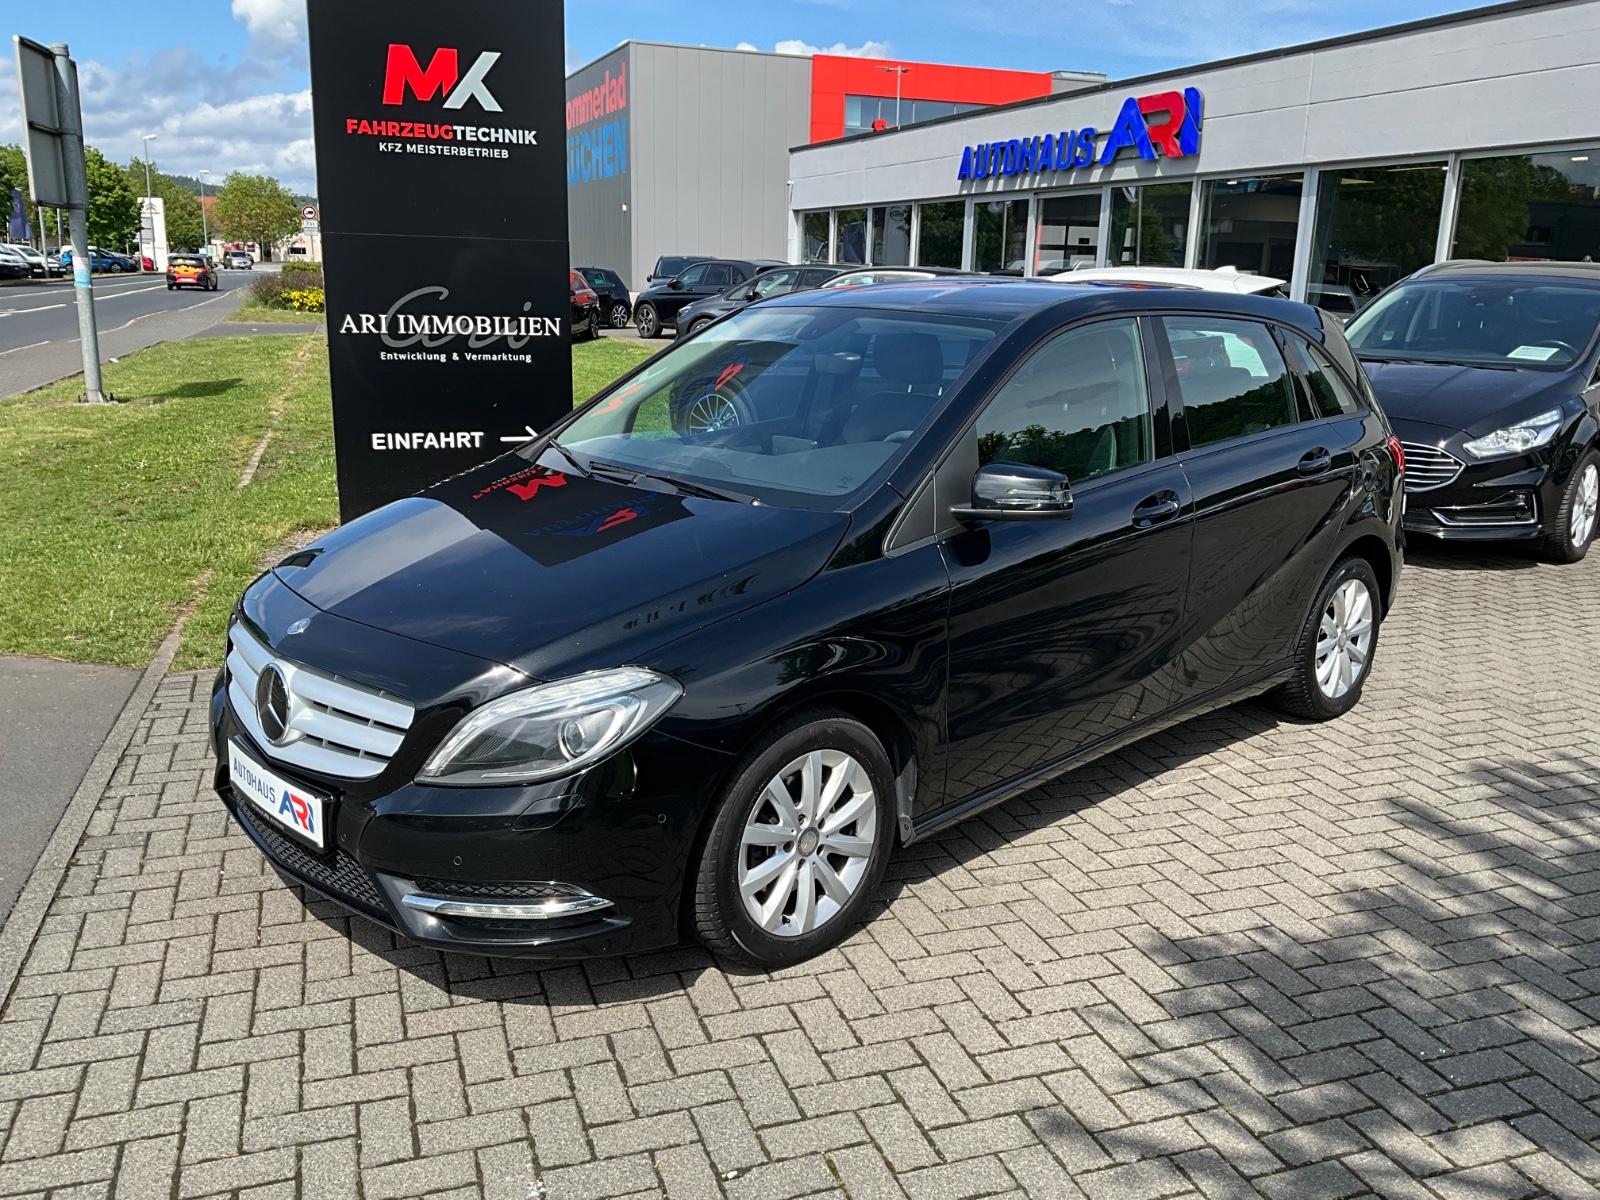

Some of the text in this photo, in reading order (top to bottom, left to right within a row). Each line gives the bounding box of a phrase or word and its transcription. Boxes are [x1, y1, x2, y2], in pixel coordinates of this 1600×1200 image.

[383, 43, 504, 113] MK
[346, 118, 539, 146] FAHRZEUGTECHNIK
[957, 86, 1205, 181] AUTOHAUS ARI
[379, 142, 510, 160] KFZ MEISTERBETRIEB
[339, 313, 562, 337] ARI IMMOBILIEN
[380, 351, 533, 364] Entwicklung & Vermarktung
[371, 430, 485, 451] EINFAHRT
[233, 757, 276, 804] AUTOHAUS
[278, 789, 316, 835] ARI
